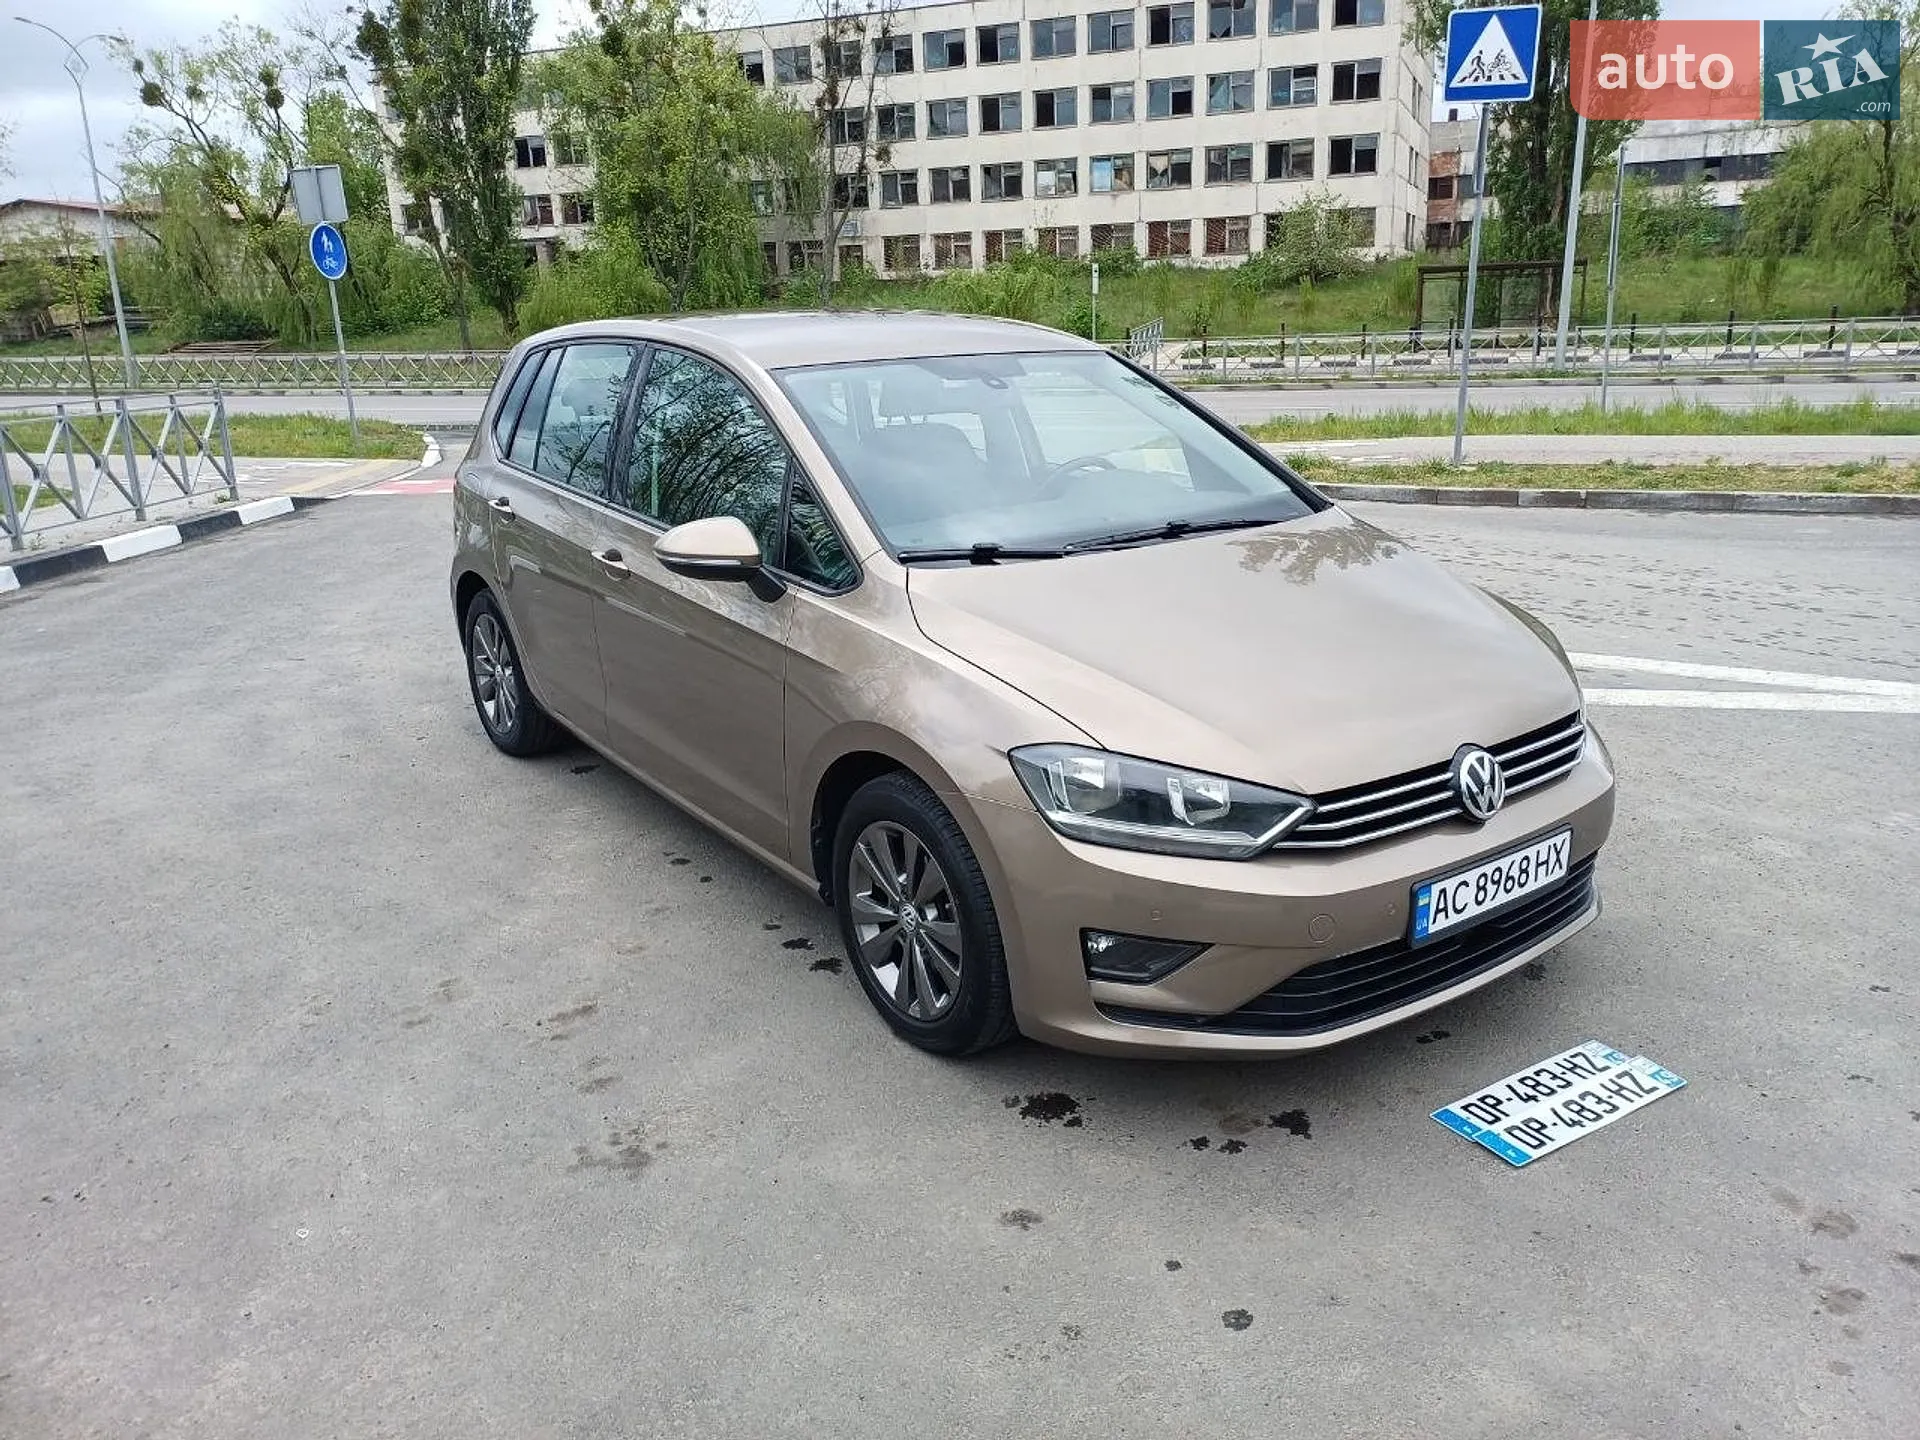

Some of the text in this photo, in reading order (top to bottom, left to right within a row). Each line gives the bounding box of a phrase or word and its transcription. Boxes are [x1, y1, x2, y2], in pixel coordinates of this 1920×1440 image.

[1432, 837, 1568, 925] AC 8968 HX
